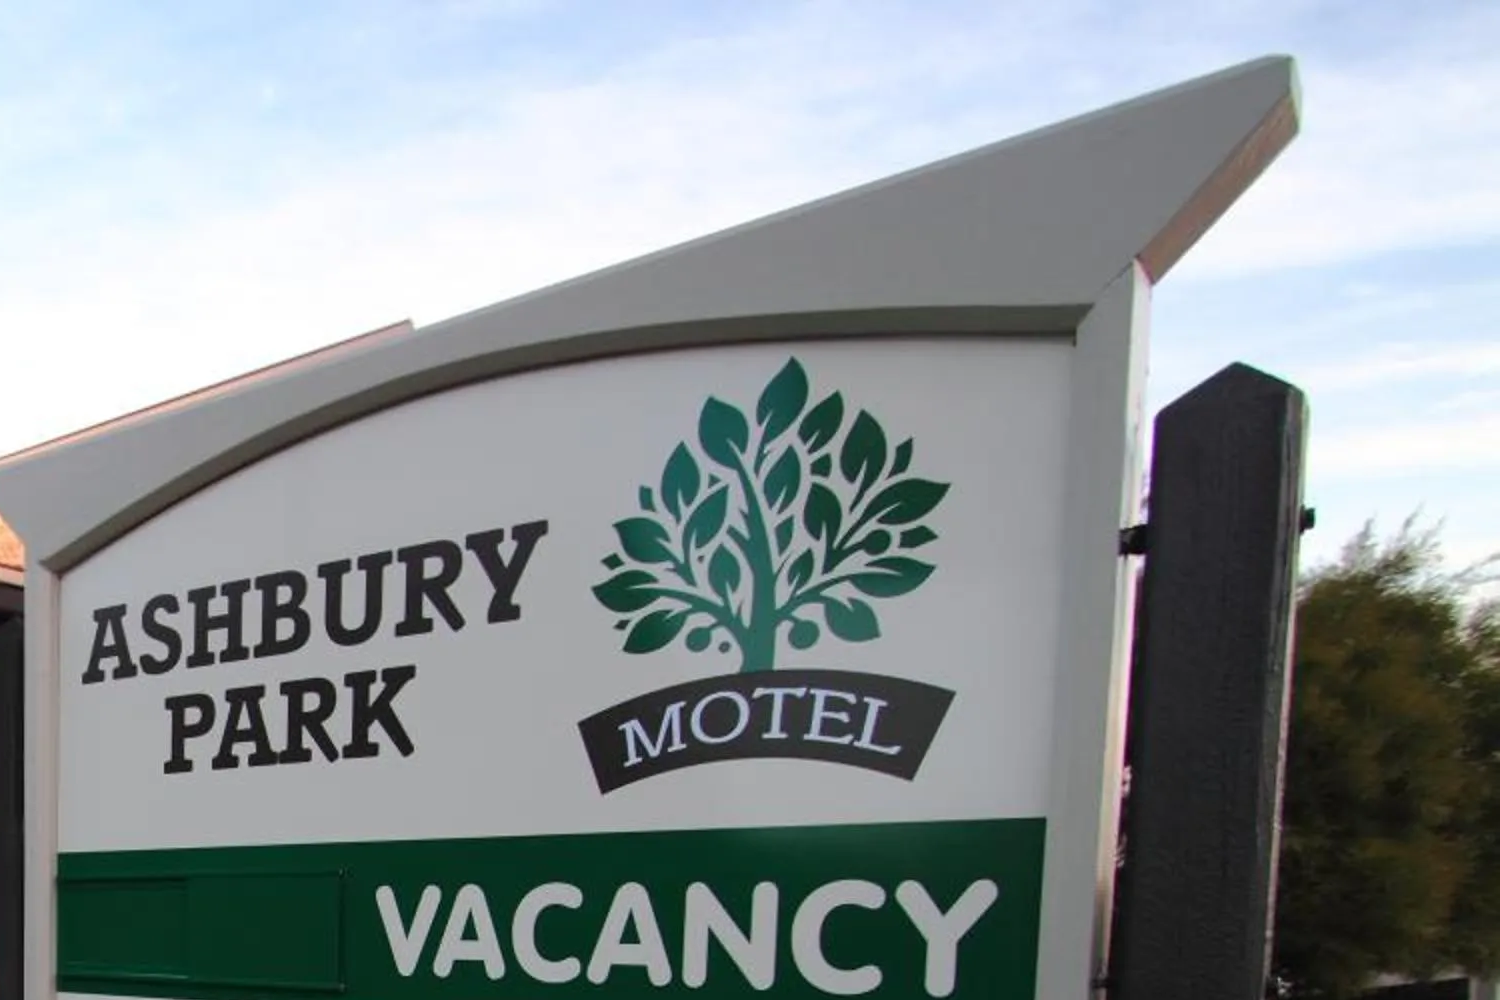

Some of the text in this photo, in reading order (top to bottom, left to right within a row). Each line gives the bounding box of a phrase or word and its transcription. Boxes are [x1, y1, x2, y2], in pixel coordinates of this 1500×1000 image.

[82, 520, 548, 684] ASHBURY
[164, 665, 416, 774] PARK
[619, 687, 902, 766] MOTEL
[375, 879, 999, 998] VACANCY
